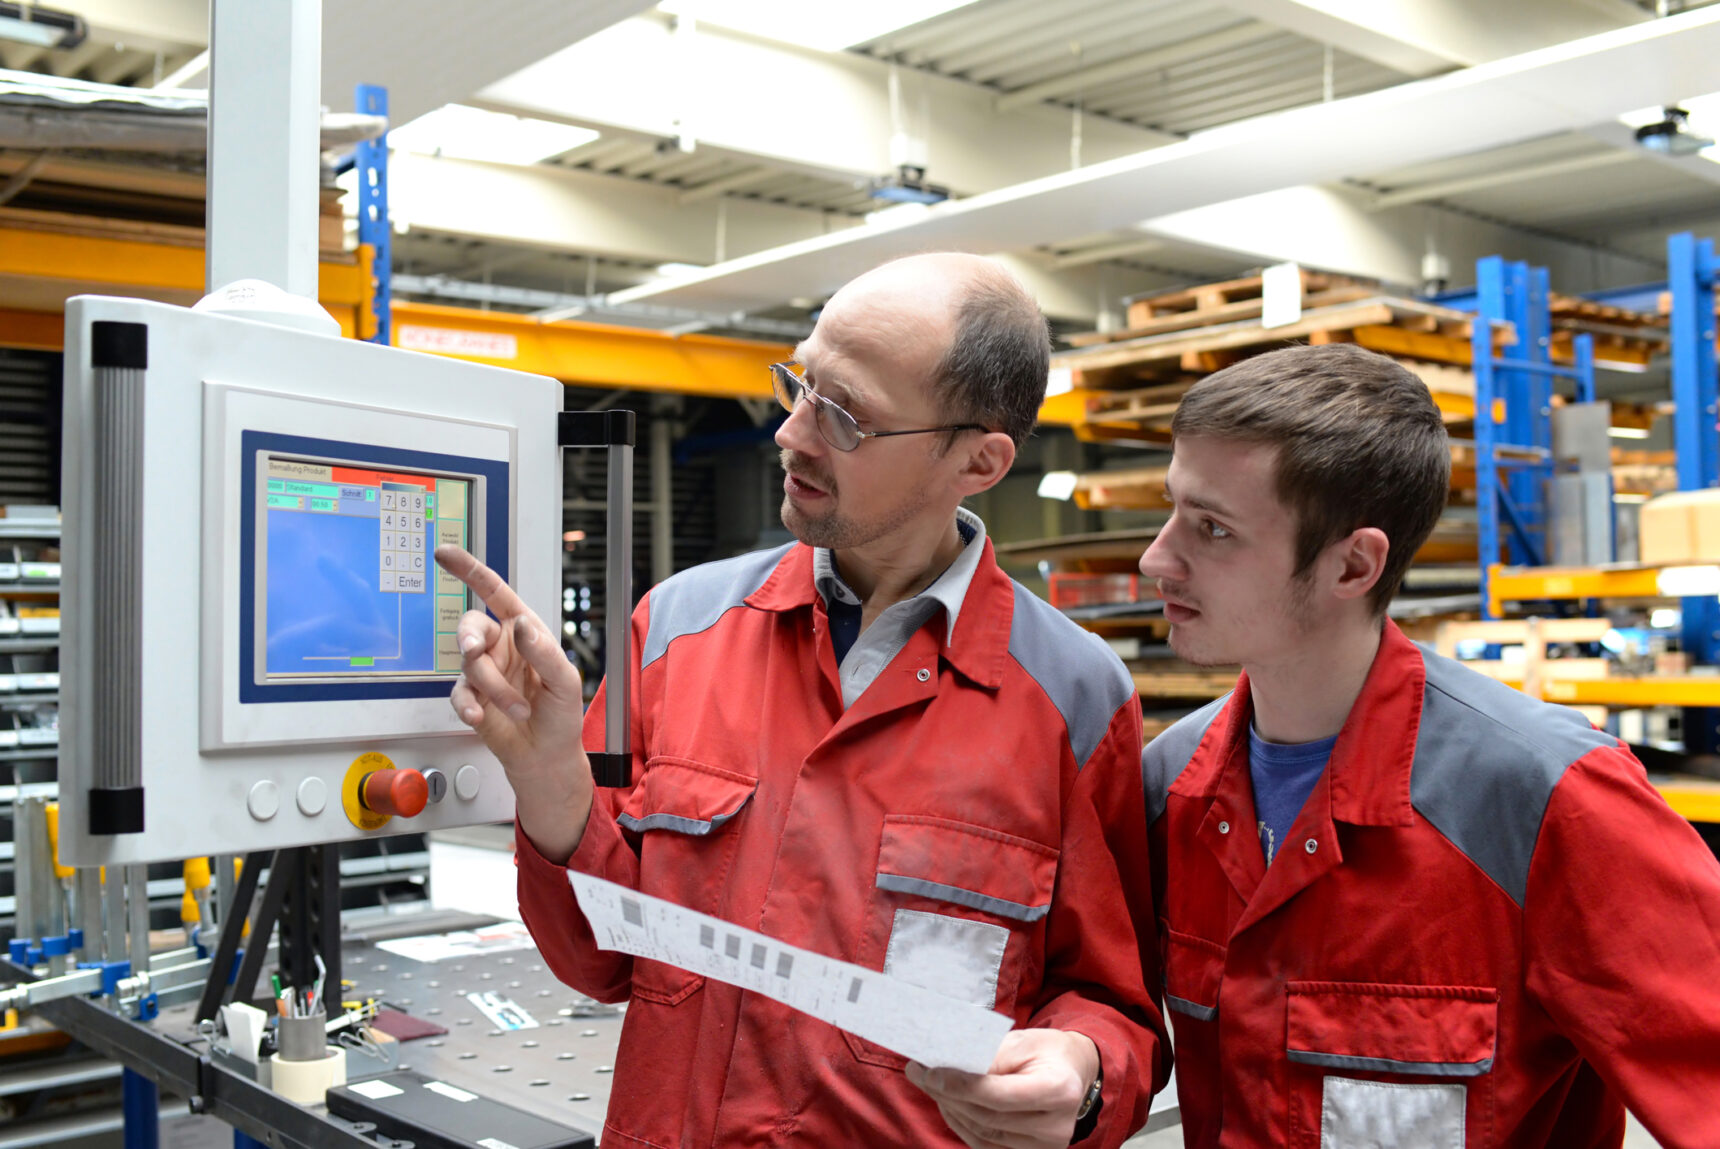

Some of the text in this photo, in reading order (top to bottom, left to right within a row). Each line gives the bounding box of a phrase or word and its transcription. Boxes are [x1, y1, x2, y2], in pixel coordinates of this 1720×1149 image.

[385, 495, 421, 509] 7 8 9
[385, 515, 421, 528] 4 5 6
[400, 536, 407, 547] 2
[415, 538, 421, 548] 3
[385, 555, 391, 566] 0
[414, 557, 422, 568] C
[399, 576, 422, 588] Enter
